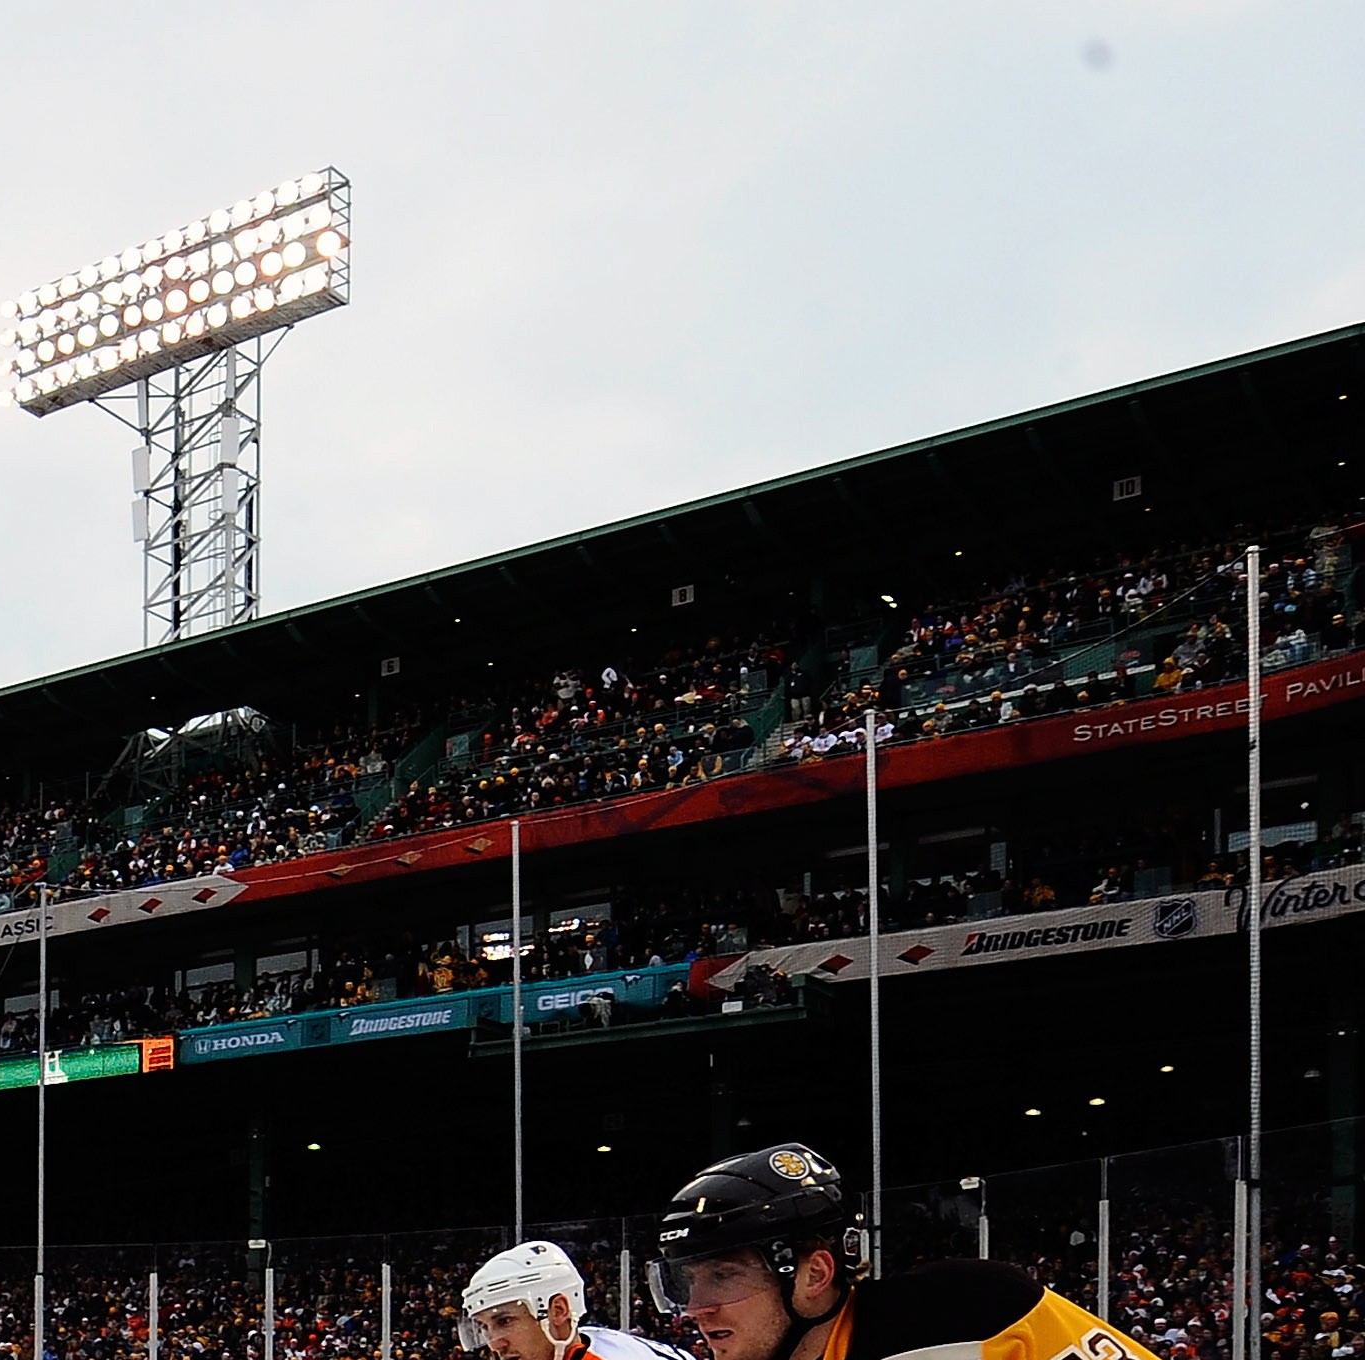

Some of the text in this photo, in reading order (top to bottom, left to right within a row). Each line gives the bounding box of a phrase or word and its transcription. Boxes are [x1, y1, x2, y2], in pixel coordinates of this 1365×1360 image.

[960, 917, 1134, 957] BRIDGESTONE
[349, 1010, 451, 1036] BRIDGESTONE
[212, 1032, 285, 1052] HONDA
